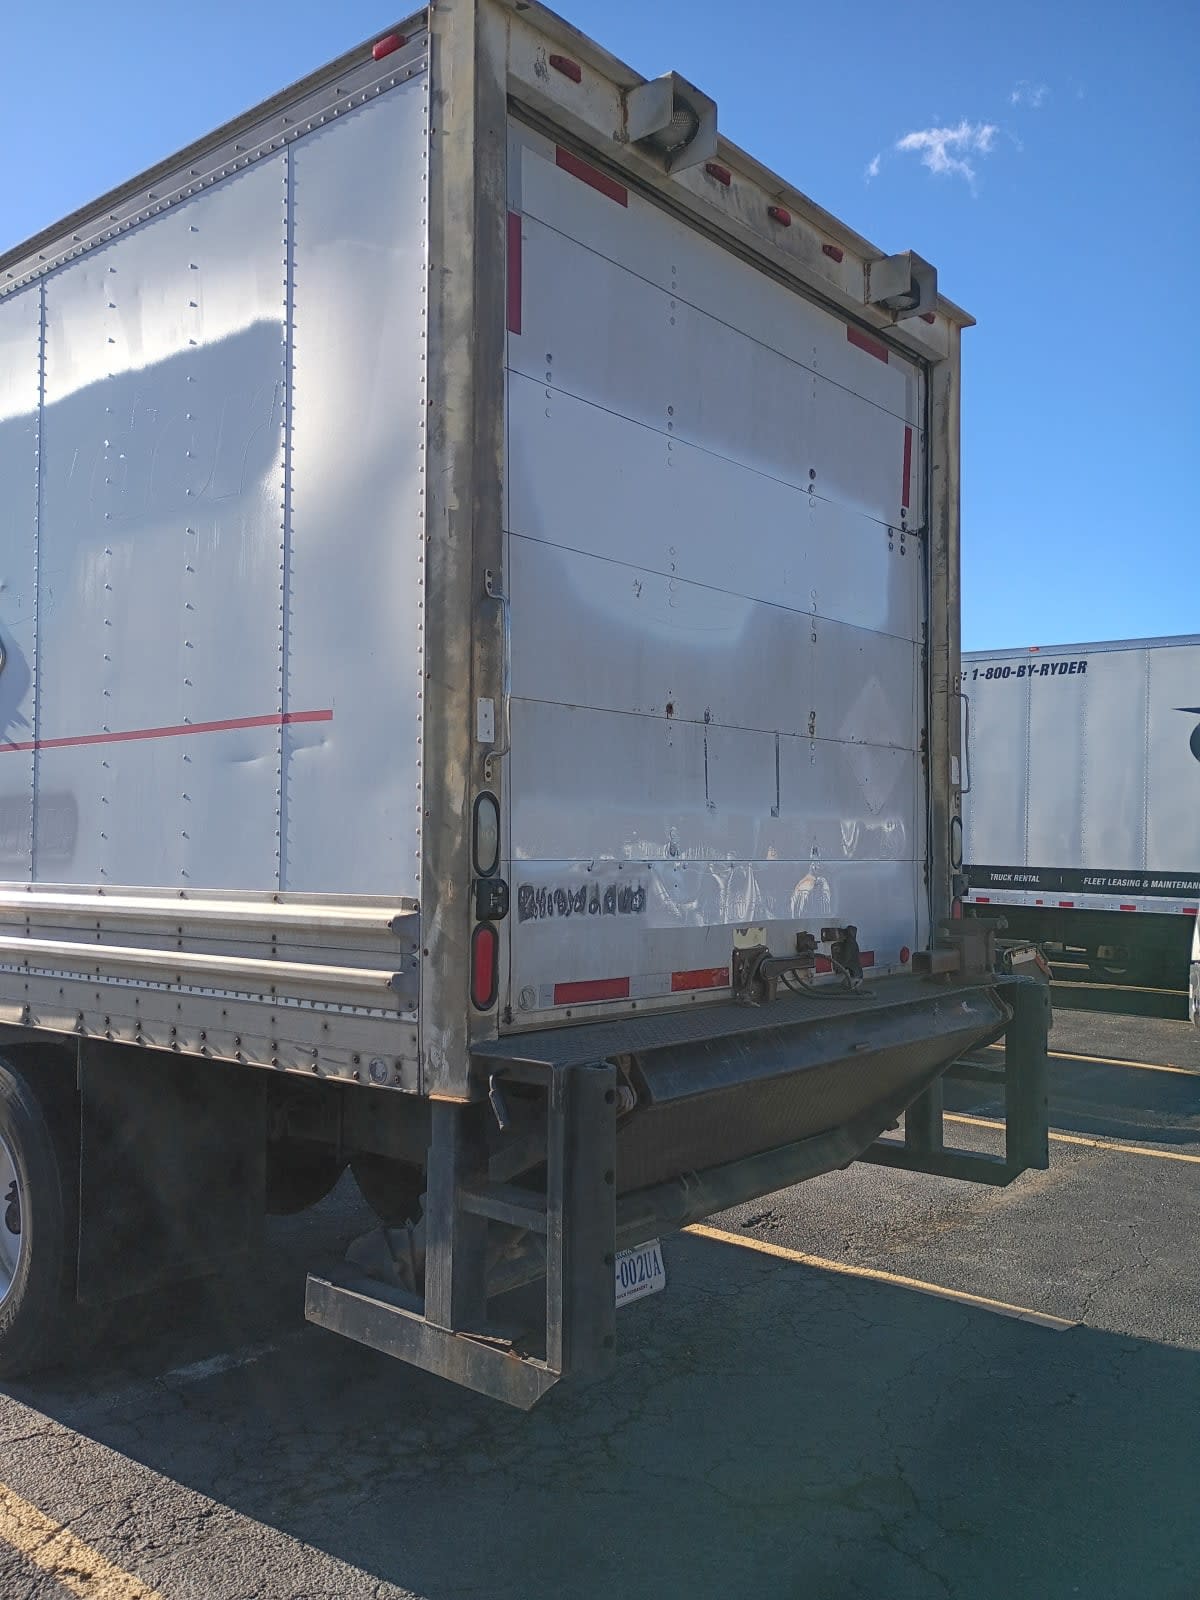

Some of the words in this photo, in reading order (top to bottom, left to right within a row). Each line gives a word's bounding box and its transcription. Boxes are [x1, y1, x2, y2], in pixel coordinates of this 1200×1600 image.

[972, 661, 1087, 681] 1-800-BY-RYDER
[990, 873, 1012, 882] TRUCK
[1013, 874, 1040, 883] RENTAL
[1083, 877, 1106, 886] FLEET
[1108, 878, 1140, 887] LEASING
[1142, 880, 1149, 888] &
[1151, 880, 1200, 890] MAINTENAN
